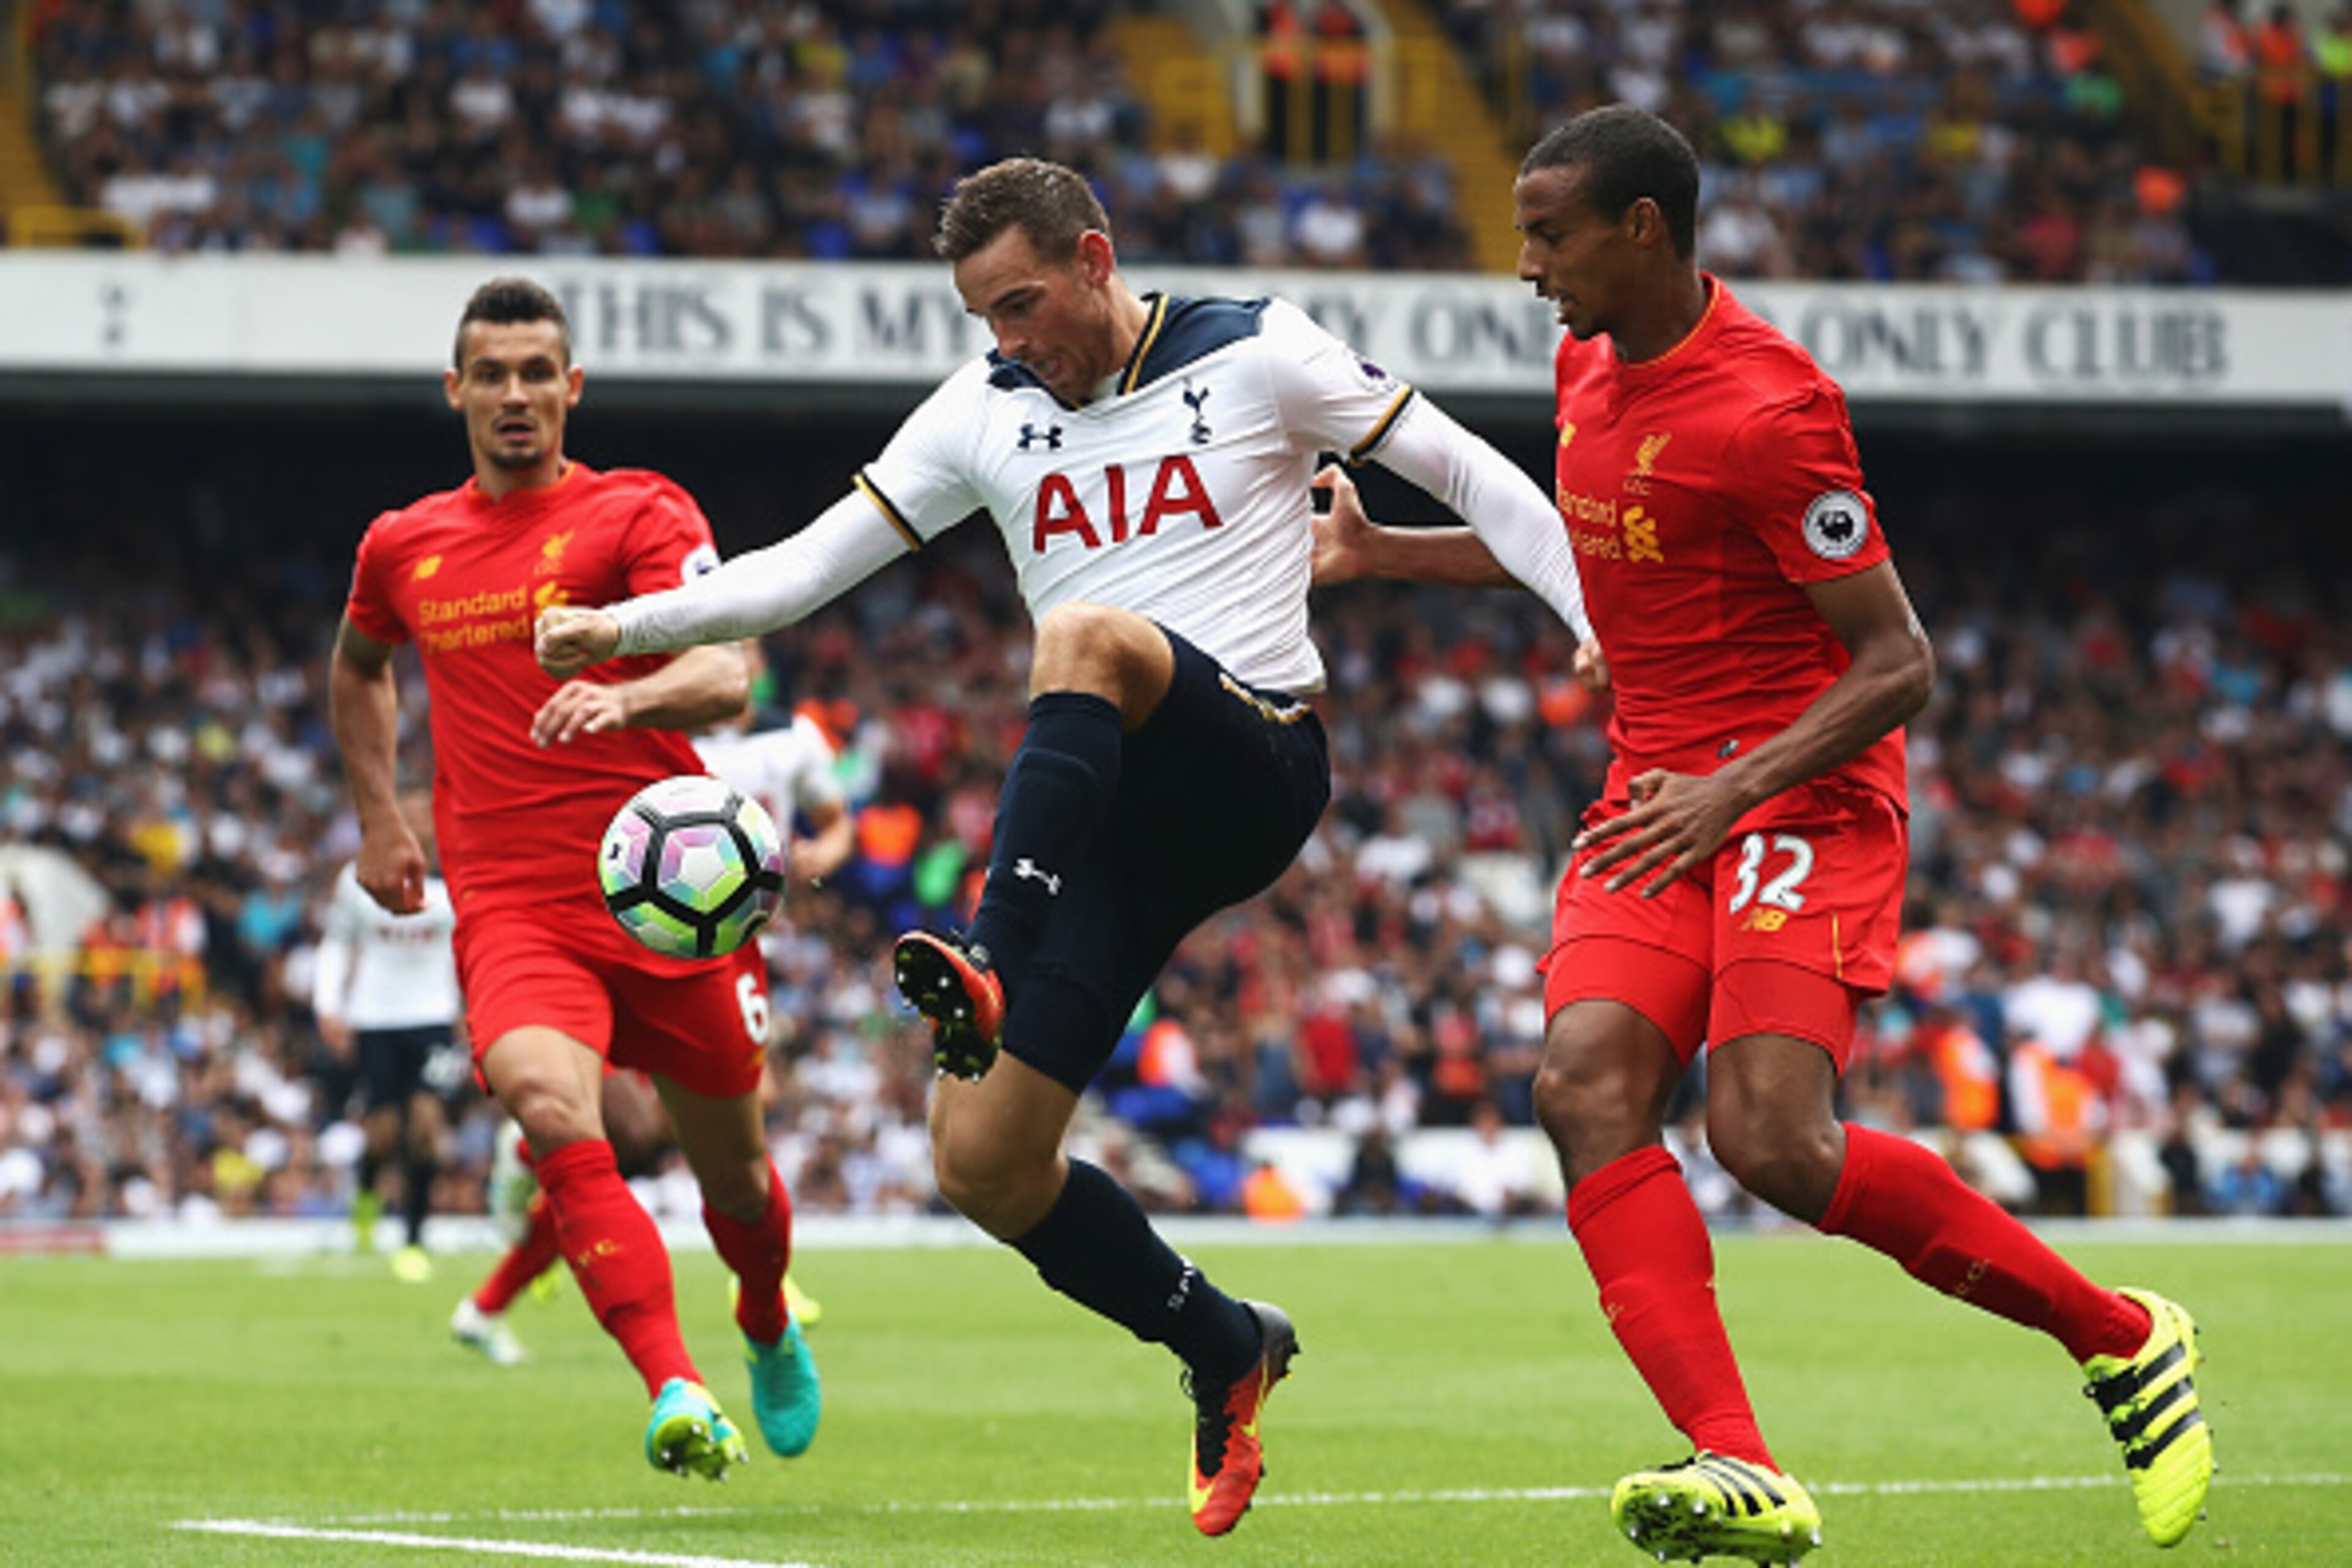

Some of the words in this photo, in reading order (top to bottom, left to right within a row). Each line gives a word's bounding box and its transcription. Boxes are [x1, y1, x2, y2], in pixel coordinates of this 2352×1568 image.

[549, 282, 739, 353] THIS
[761, 288, 833, 356] IS
[855, 290, 969, 358] MY
[1802, 300, 2010, 377] ONLY
[2022, 303, 2231, 381] CLUB
[1033, 454, 1223, 551] AIA
[418, 586, 529, 627] Standard
[1729, 832, 1814, 915] 32
[736, 973, 769, 1044] 6
